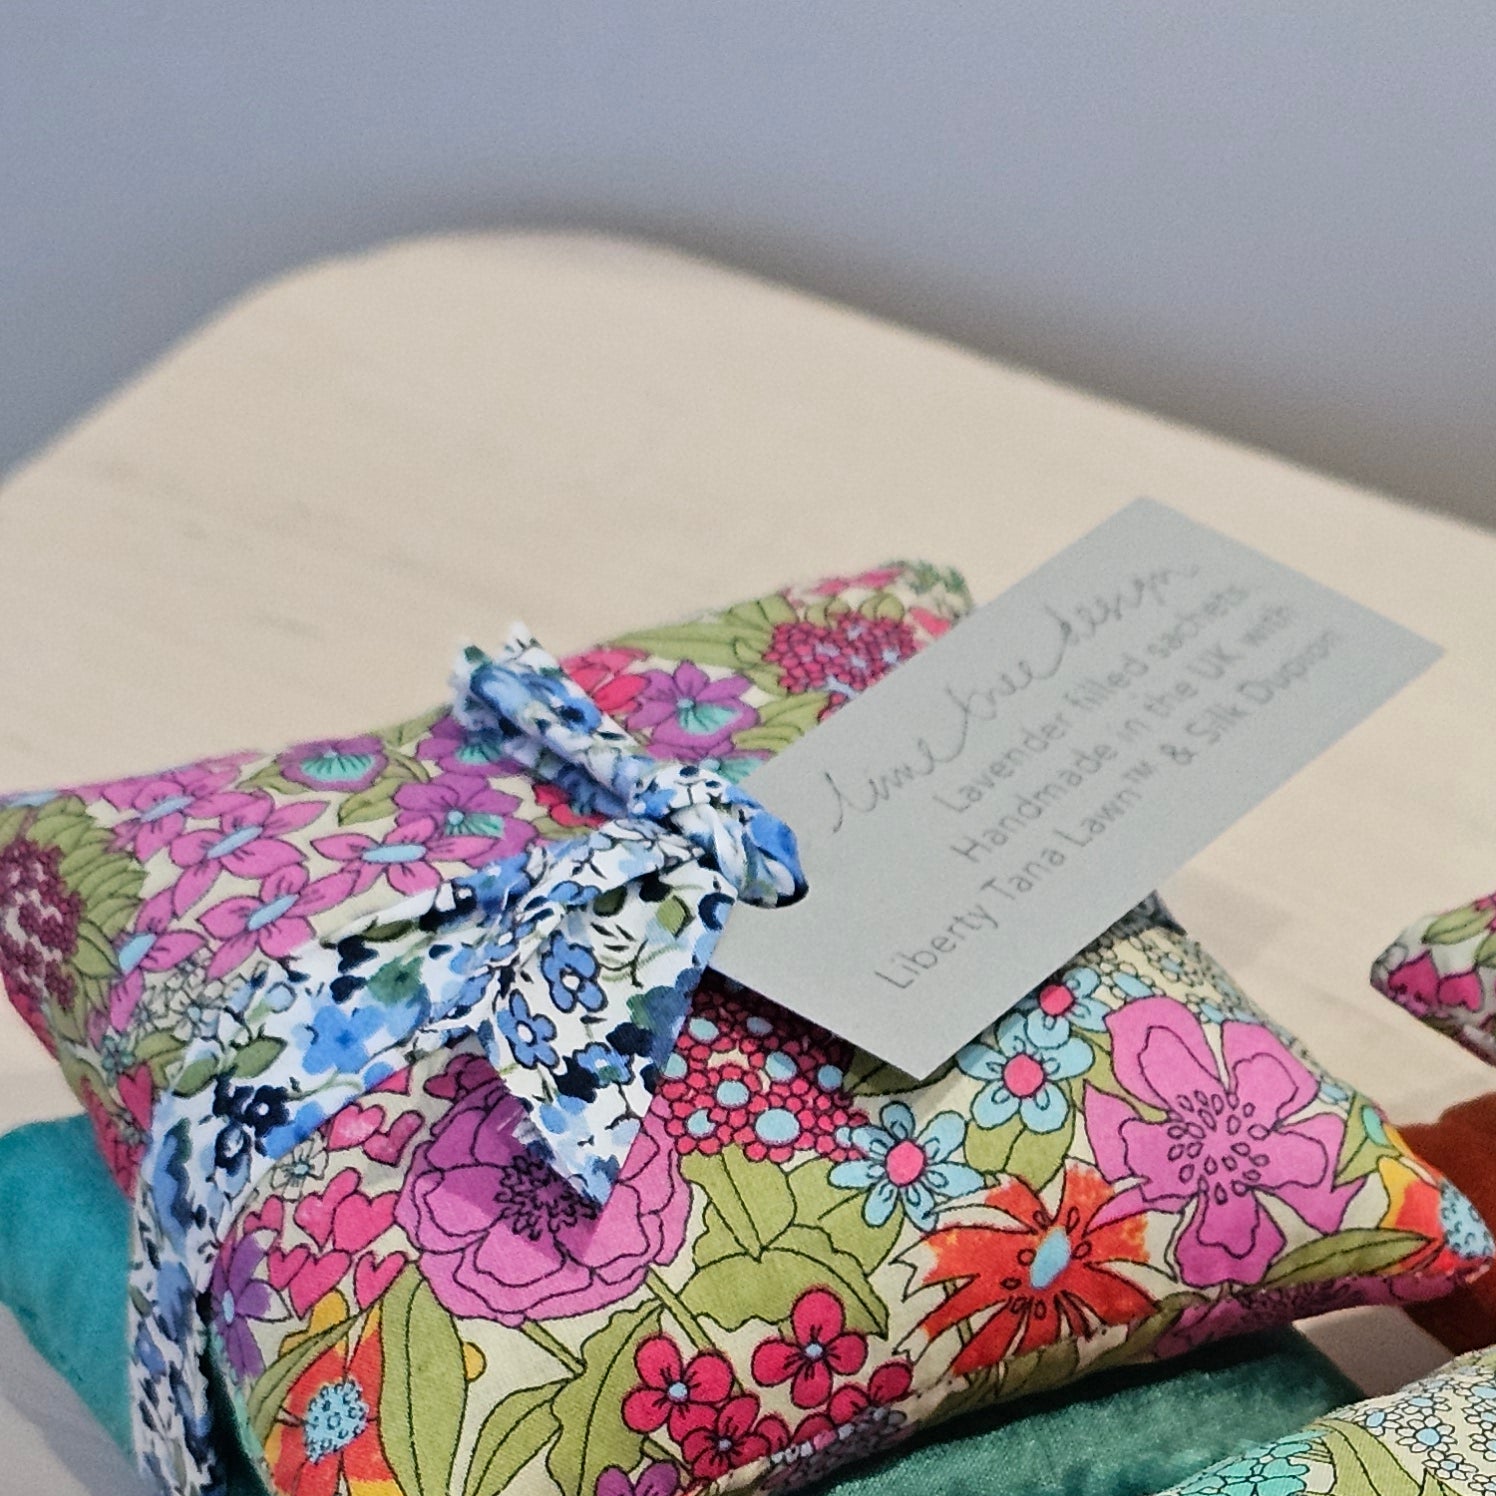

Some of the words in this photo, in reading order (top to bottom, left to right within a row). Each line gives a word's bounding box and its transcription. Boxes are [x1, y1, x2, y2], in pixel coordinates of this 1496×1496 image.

[874, 902, 1000, 990] Liberty
[982, 847, 1066, 901] Tana
[1160, 743, 1197, 766] &
[1185, 700, 1248, 746] Silk
[1239, 630, 1336, 706] Dupion
[933, 708, 1072, 814] Lavender
[1066, 655, 1149, 712] filled
[1146, 584, 1251, 659] sachets
[952, 744, 1118, 861] Handmade
[1115, 714, 1147, 745] in
[1145, 680, 1199, 718] the
[1191, 642, 1238, 682] UK
[1242, 606, 1294, 646] with
